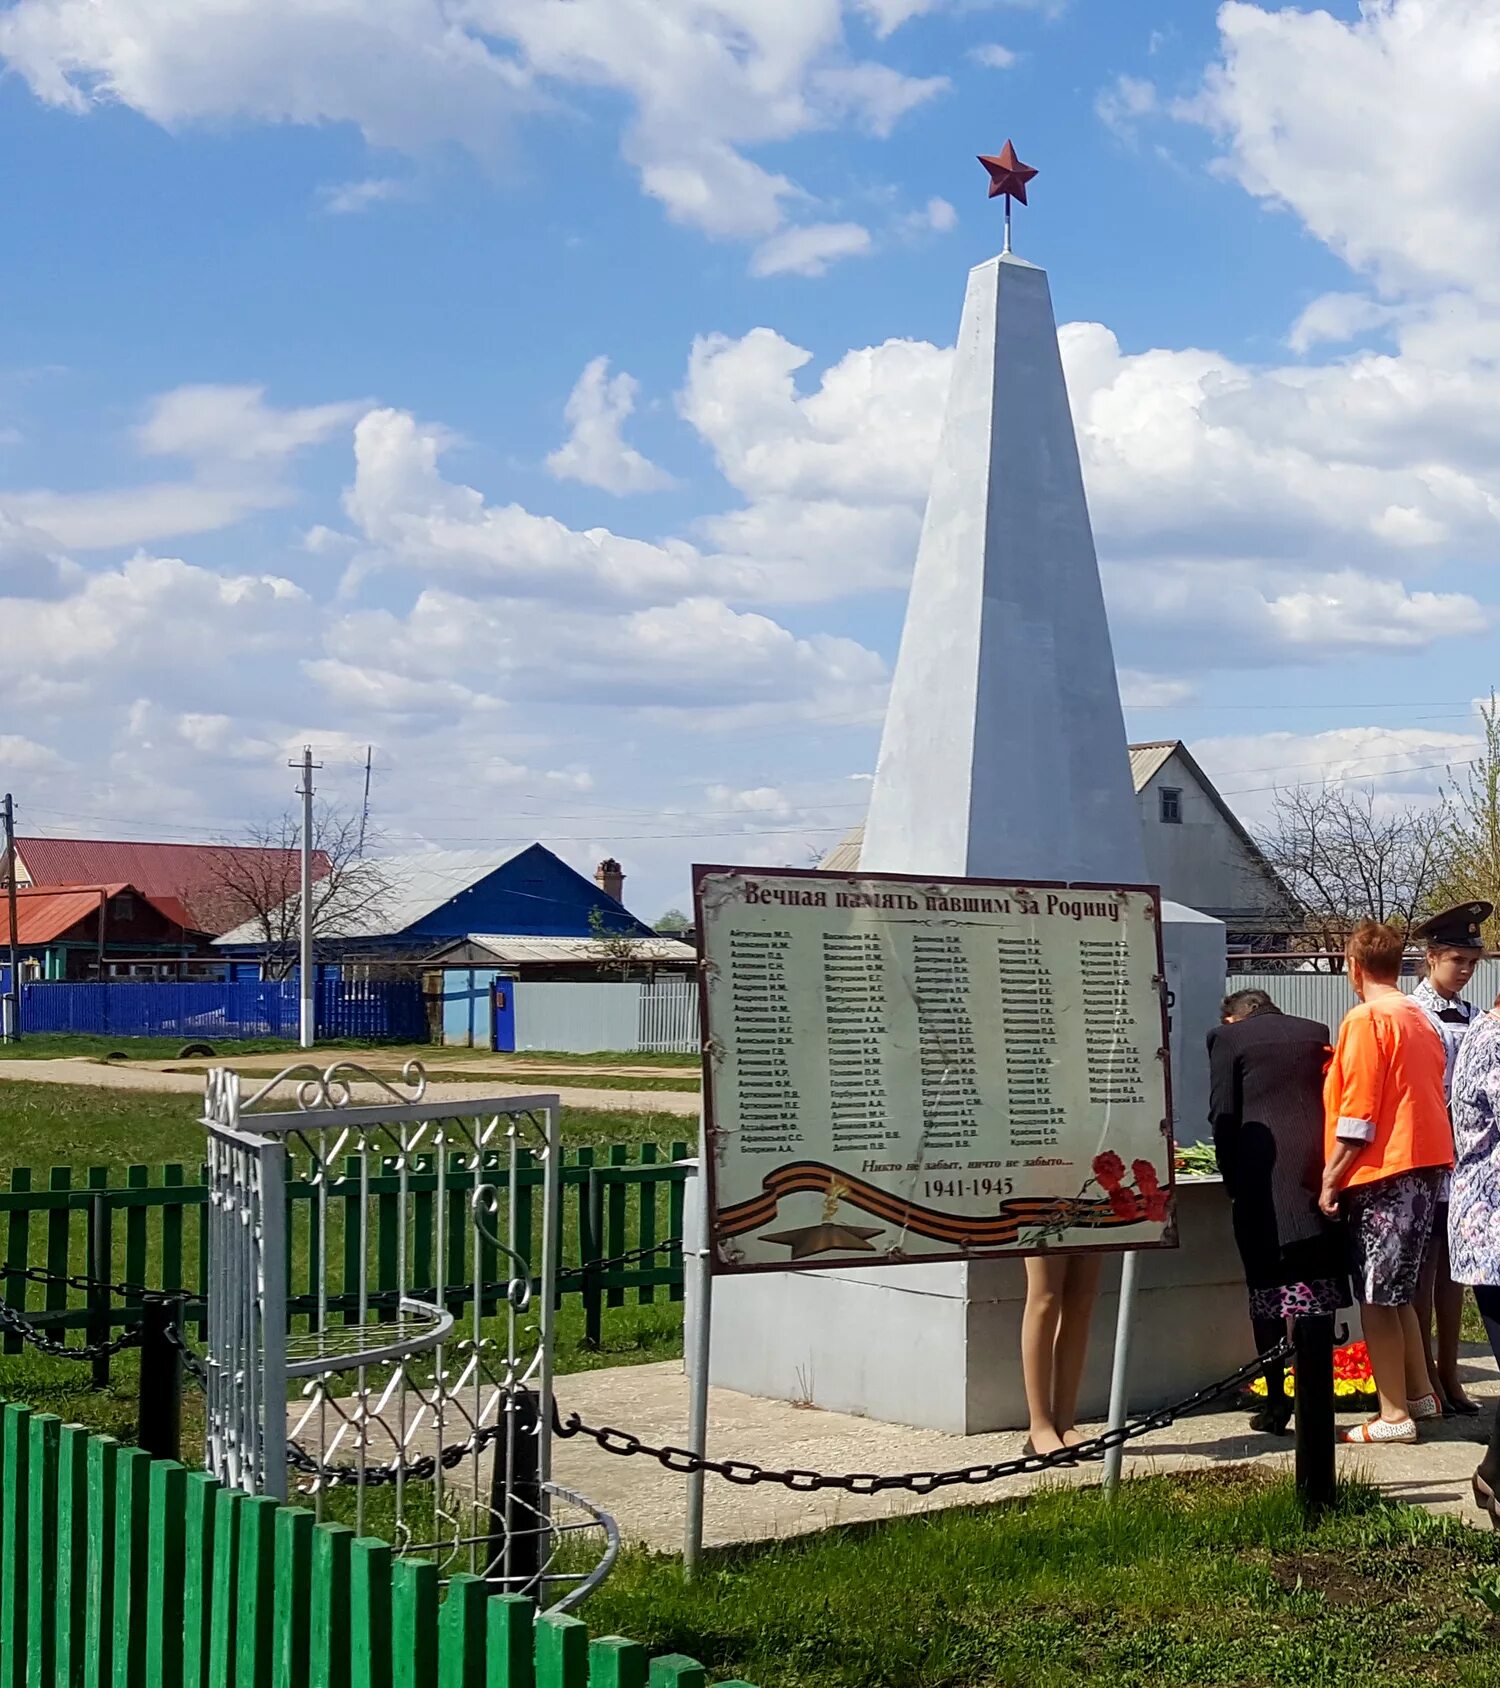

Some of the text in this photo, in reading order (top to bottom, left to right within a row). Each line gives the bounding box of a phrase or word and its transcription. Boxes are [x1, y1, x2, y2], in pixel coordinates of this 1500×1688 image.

[744, 882, 1119, 922] Вечная память павшим за Родину
[777, 1145, 794, 1153] А.А.
[861, 1160, 902, 1173] Никто
[906, 1162, 920, 1171] не
[967, 1161, 1001, 1169] ничто
[1005, 1160, 1020, 1168] не
[924, 1177, 1013, 1198] 1941-1945
